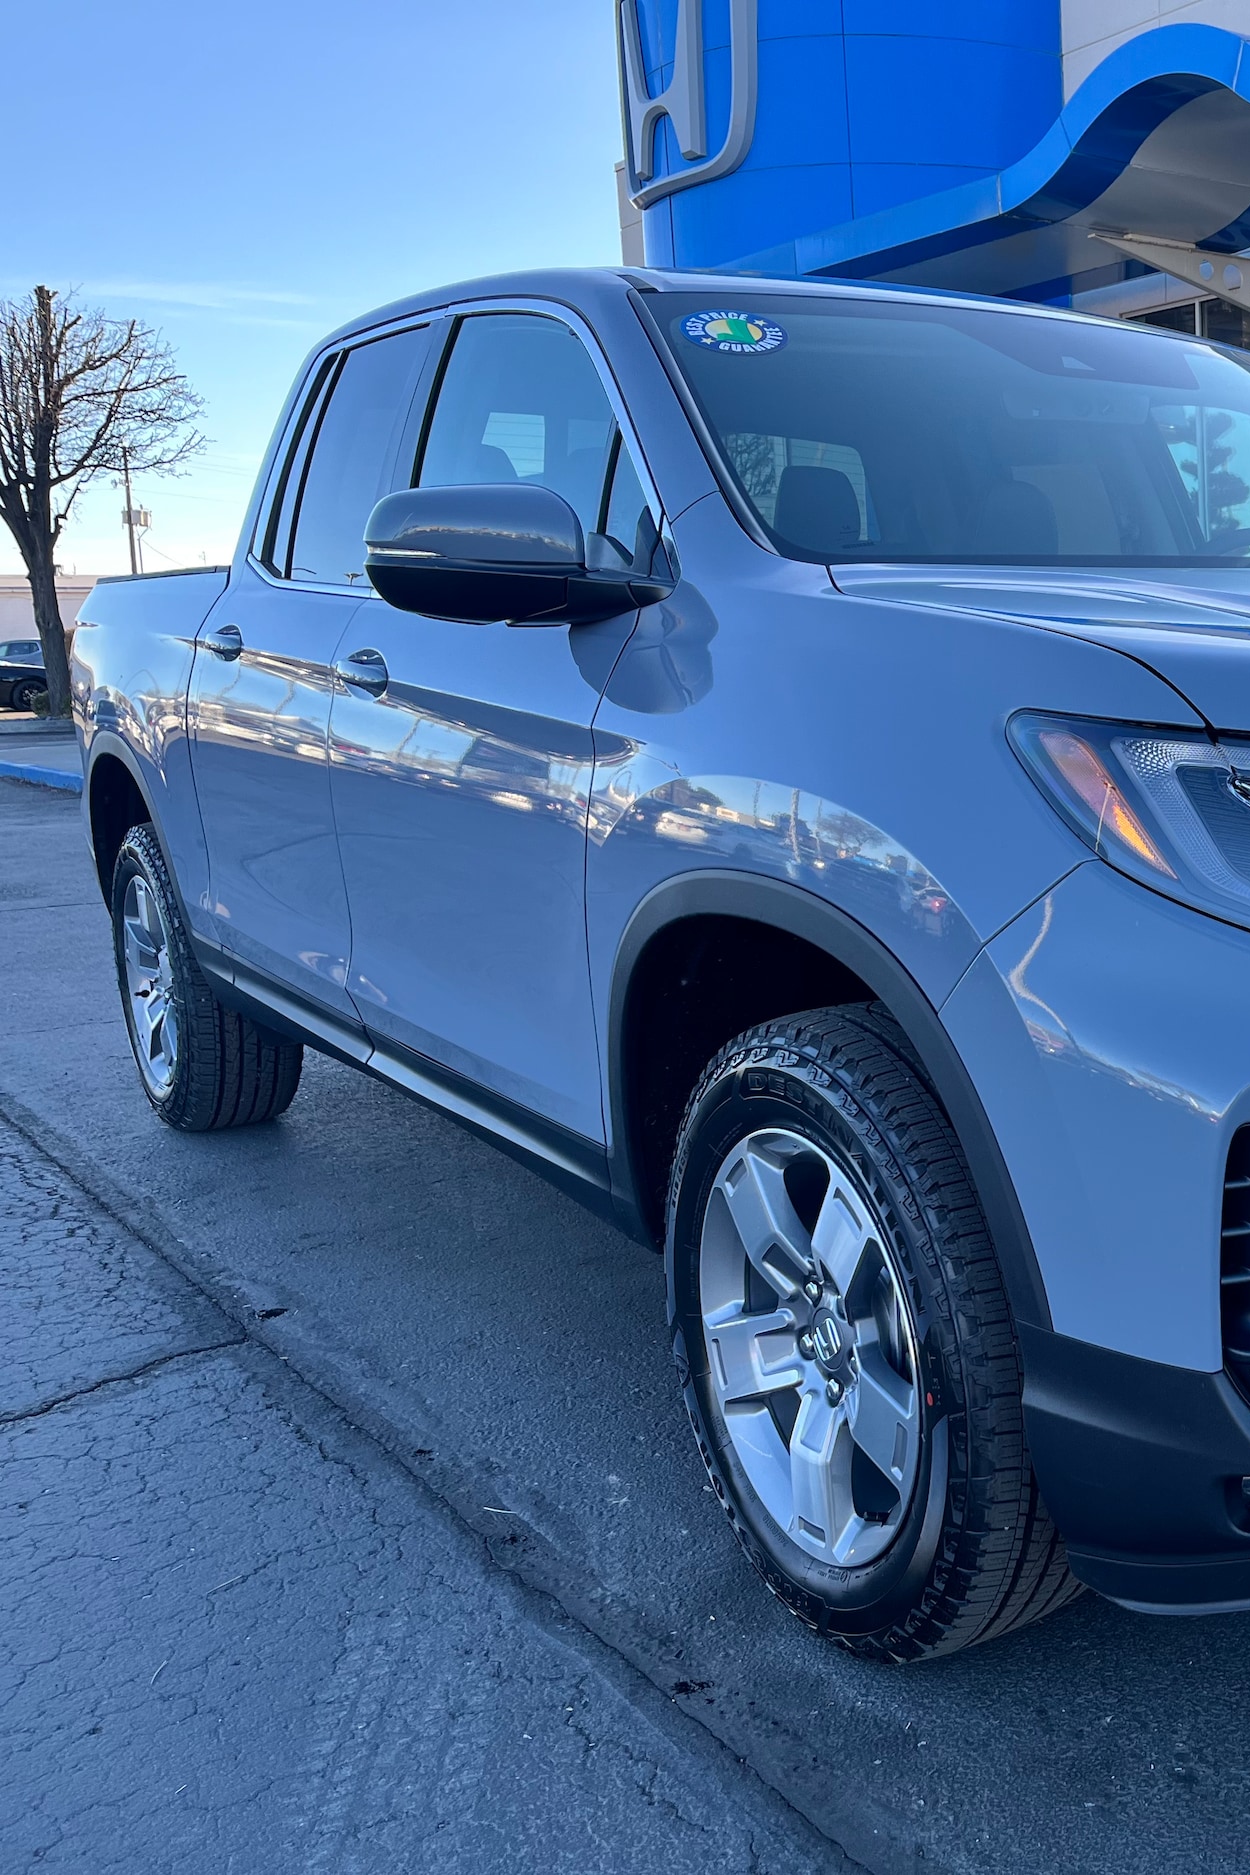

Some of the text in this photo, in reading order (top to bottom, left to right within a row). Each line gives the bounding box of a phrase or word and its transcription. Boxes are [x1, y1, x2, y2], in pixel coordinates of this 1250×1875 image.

[686, 311, 748, 336] BEST PRICE
[718, 327, 784, 353] GUARANTEE
[744, 1071, 927, 1316] DESTINATION
